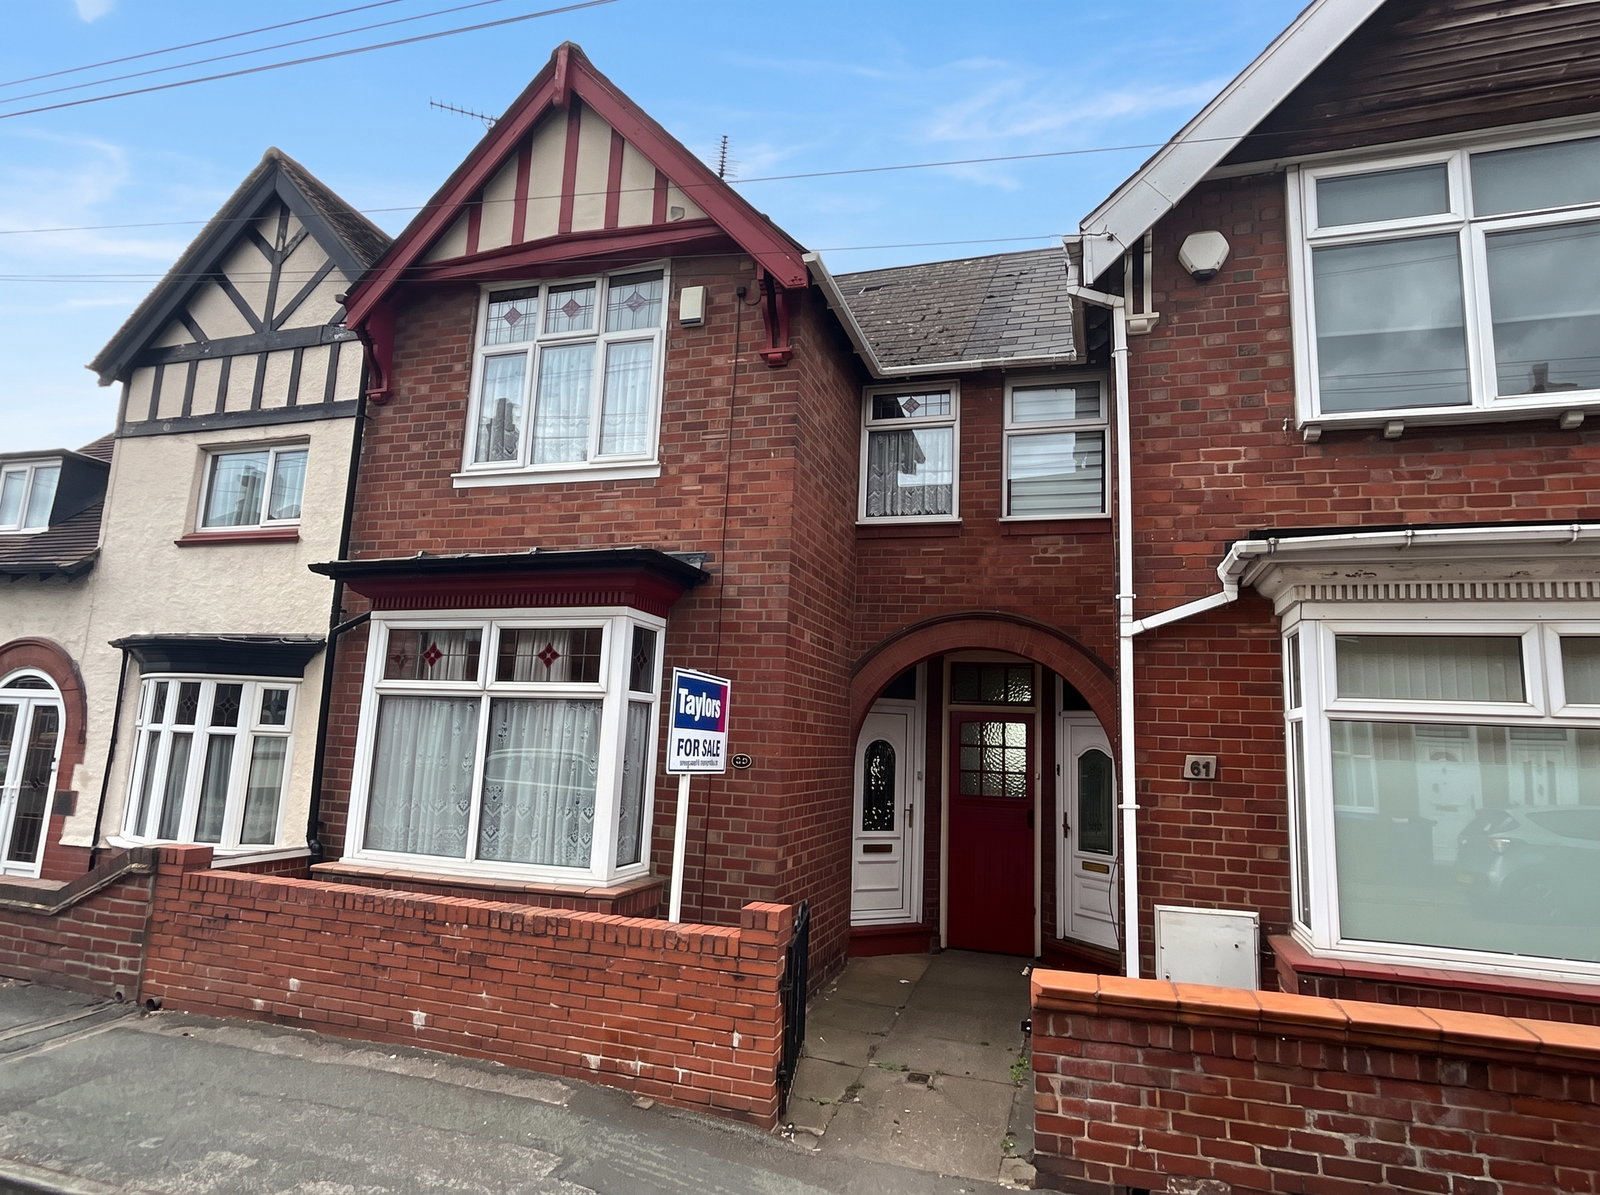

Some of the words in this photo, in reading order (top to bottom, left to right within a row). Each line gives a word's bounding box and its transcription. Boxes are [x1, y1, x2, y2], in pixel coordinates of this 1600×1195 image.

[678, 687, 721, 721] Taylors
[677, 738, 700, 757] FOR
[701, 738, 721, 757] SALE
[1190, 760, 1210, 777] 61
